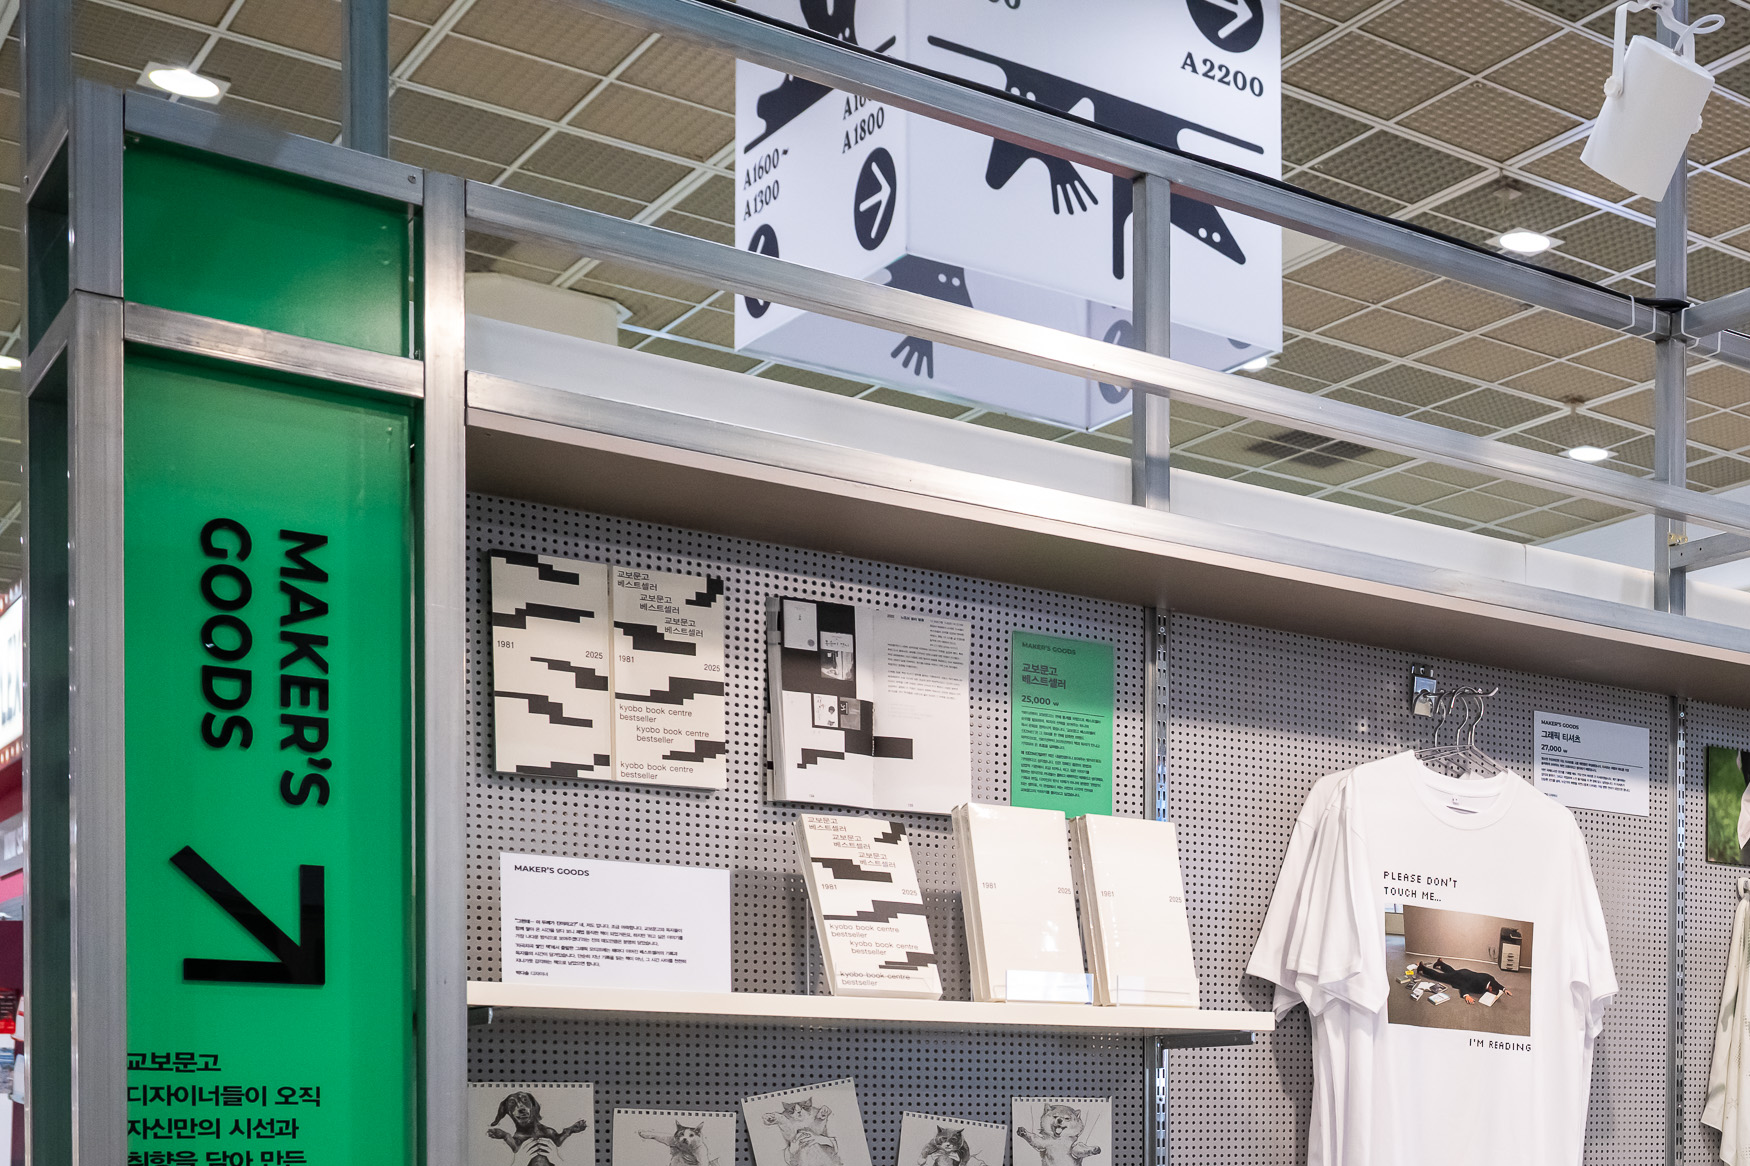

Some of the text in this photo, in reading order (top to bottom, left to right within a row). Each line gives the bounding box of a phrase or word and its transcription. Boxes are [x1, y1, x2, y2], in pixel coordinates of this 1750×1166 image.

[1180, 51, 1264, 97] A2200
[841, 106, 885, 154] A1800
[743, 179, 780, 221] A1300
[617, 571, 649, 580] 교보문고
[617, 579, 658, 591] 베스트셀러
[640, 593, 672, 604] 교보문고
[640, 603, 680, 614] 베스트셀러
[664, 617, 696, 627] 교보문고
[200, 518, 253, 750] GOODS
[664, 626, 704, 638] 베스트셀러
[497, 640, 514, 649] 1981
[585, 651, 603, 660] 2025
[618, 655, 635, 663] 1981
[280, 529, 332, 807] MAKER'S
[704, 664, 721, 672] 2025
[1022, 663, 1057, 676] 교보문고
[1022, 675, 1066, 689] 베스트셀러
[1022, 695, 1050, 705] 25,000
[619, 704, 692, 717] kyobo book centre
[619, 713, 657, 723] bestseller
[636, 725, 709, 738] kyobo book centre
[1541, 730, 1581, 743] 그래픽 티셔츠
[636, 735, 674, 744] bestseller
[1541, 744, 1561, 752] 27,000
[620, 761, 644, 772] kyobo
[647, 763, 667, 771] book
[620, 770, 658, 780] bestseller
[514, 865, 589, 876] MAKER'S GOODS
[1383, 871, 1458, 888] PLEASE DON'T
[1383, 887, 1417, 899] TOUCH
[1469, 1038, 1532, 1052] I'M READING
[127, 1052, 221, 1073] 교보문고
[127, 1085, 320, 1107] 디자이너들이 오직
[127, 1118, 299, 1139] 자신만의 시선과
